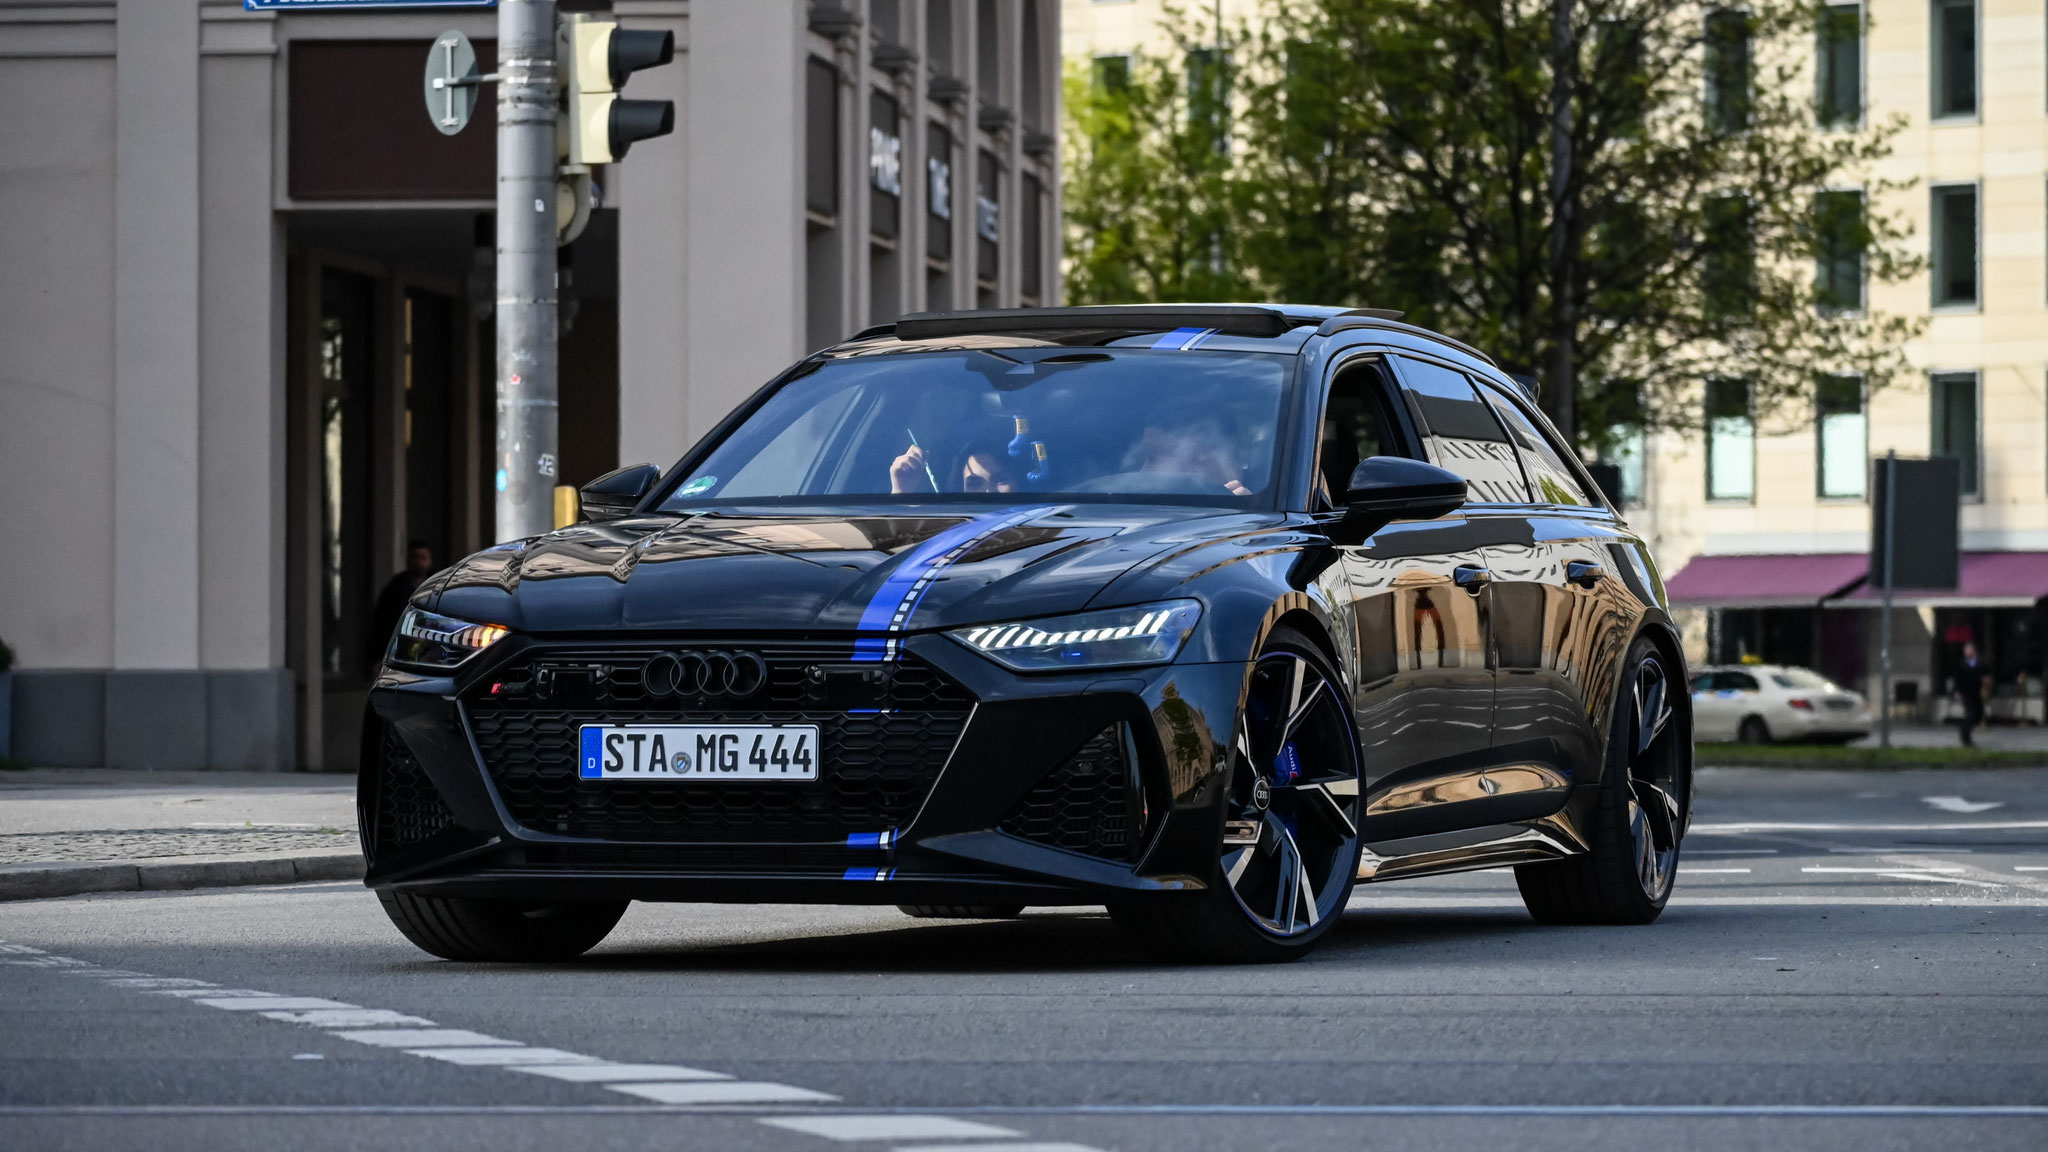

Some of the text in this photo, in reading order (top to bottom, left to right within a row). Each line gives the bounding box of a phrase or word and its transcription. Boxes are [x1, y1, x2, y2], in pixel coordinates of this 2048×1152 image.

[587, 757, 596, 769] D
[604, 733, 812, 773] STA MG 444
[1288, 746, 1296, 770] Audi
